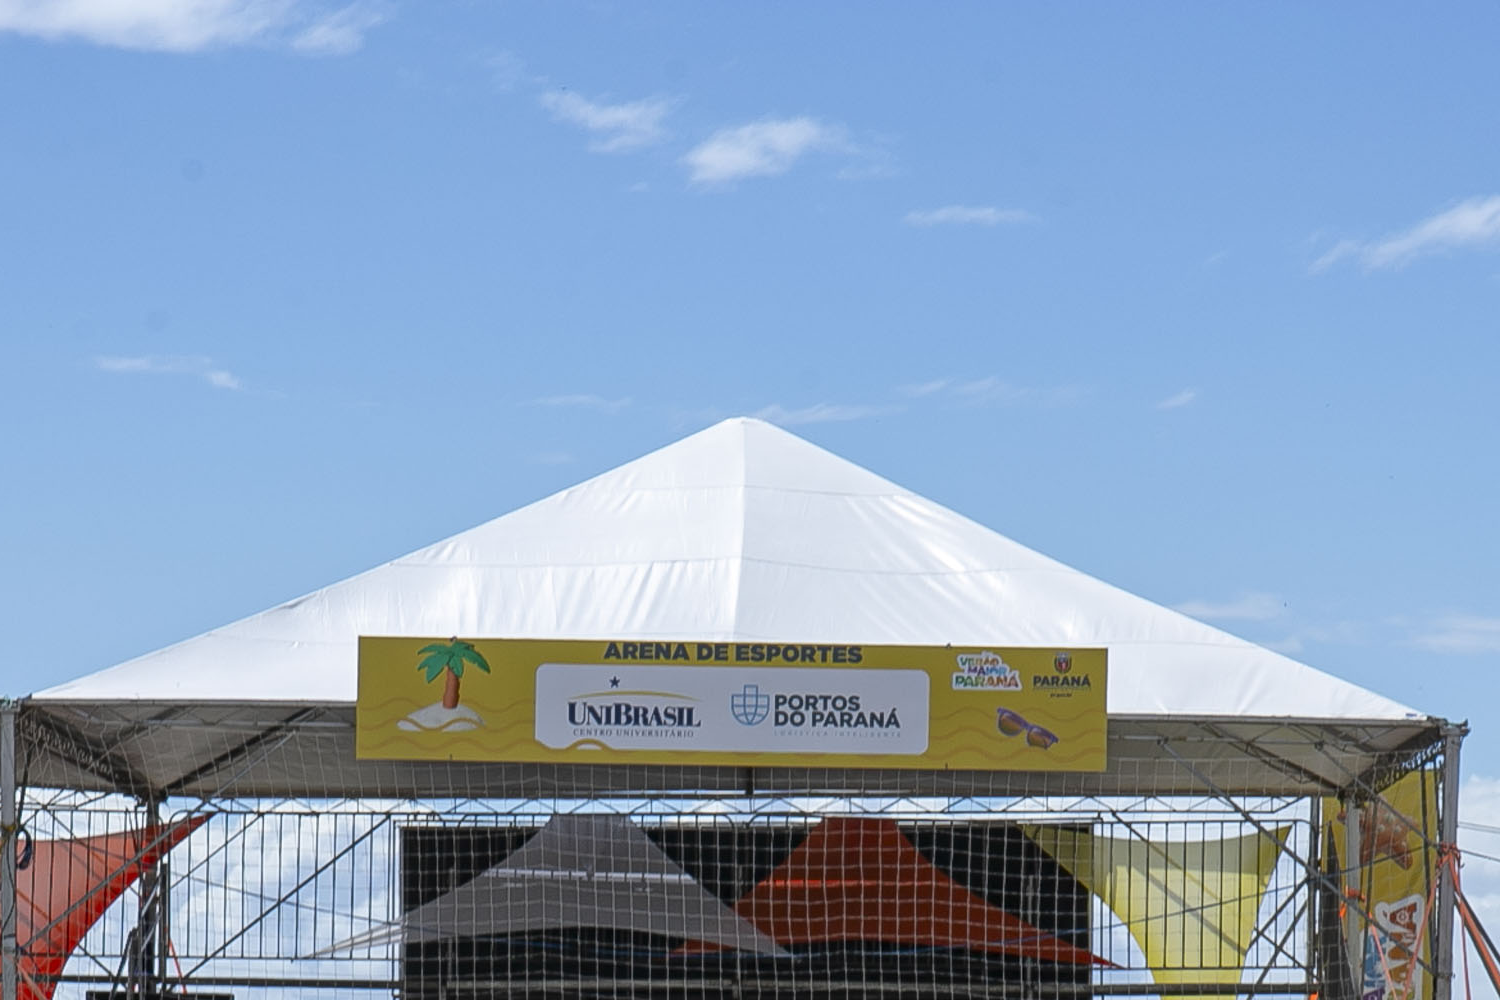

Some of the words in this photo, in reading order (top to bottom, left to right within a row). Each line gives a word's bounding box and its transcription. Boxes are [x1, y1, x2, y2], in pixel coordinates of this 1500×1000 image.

[604, 641, 690, 660] ARENA
[697, 643, 728, 661] DE
[735, 645, 863, 664] ESPORTES
[1034, 674, 1091, 687] PARANÁ
[774, 694, 861, 712] PORTOS
[774, 711, 806, 727] DO
[811, 707, 901, 729] PARANÁ
[573, 728, 613, 737] CENTRO
[616, 728, 694, 738] UNIVERSITÁRIO
